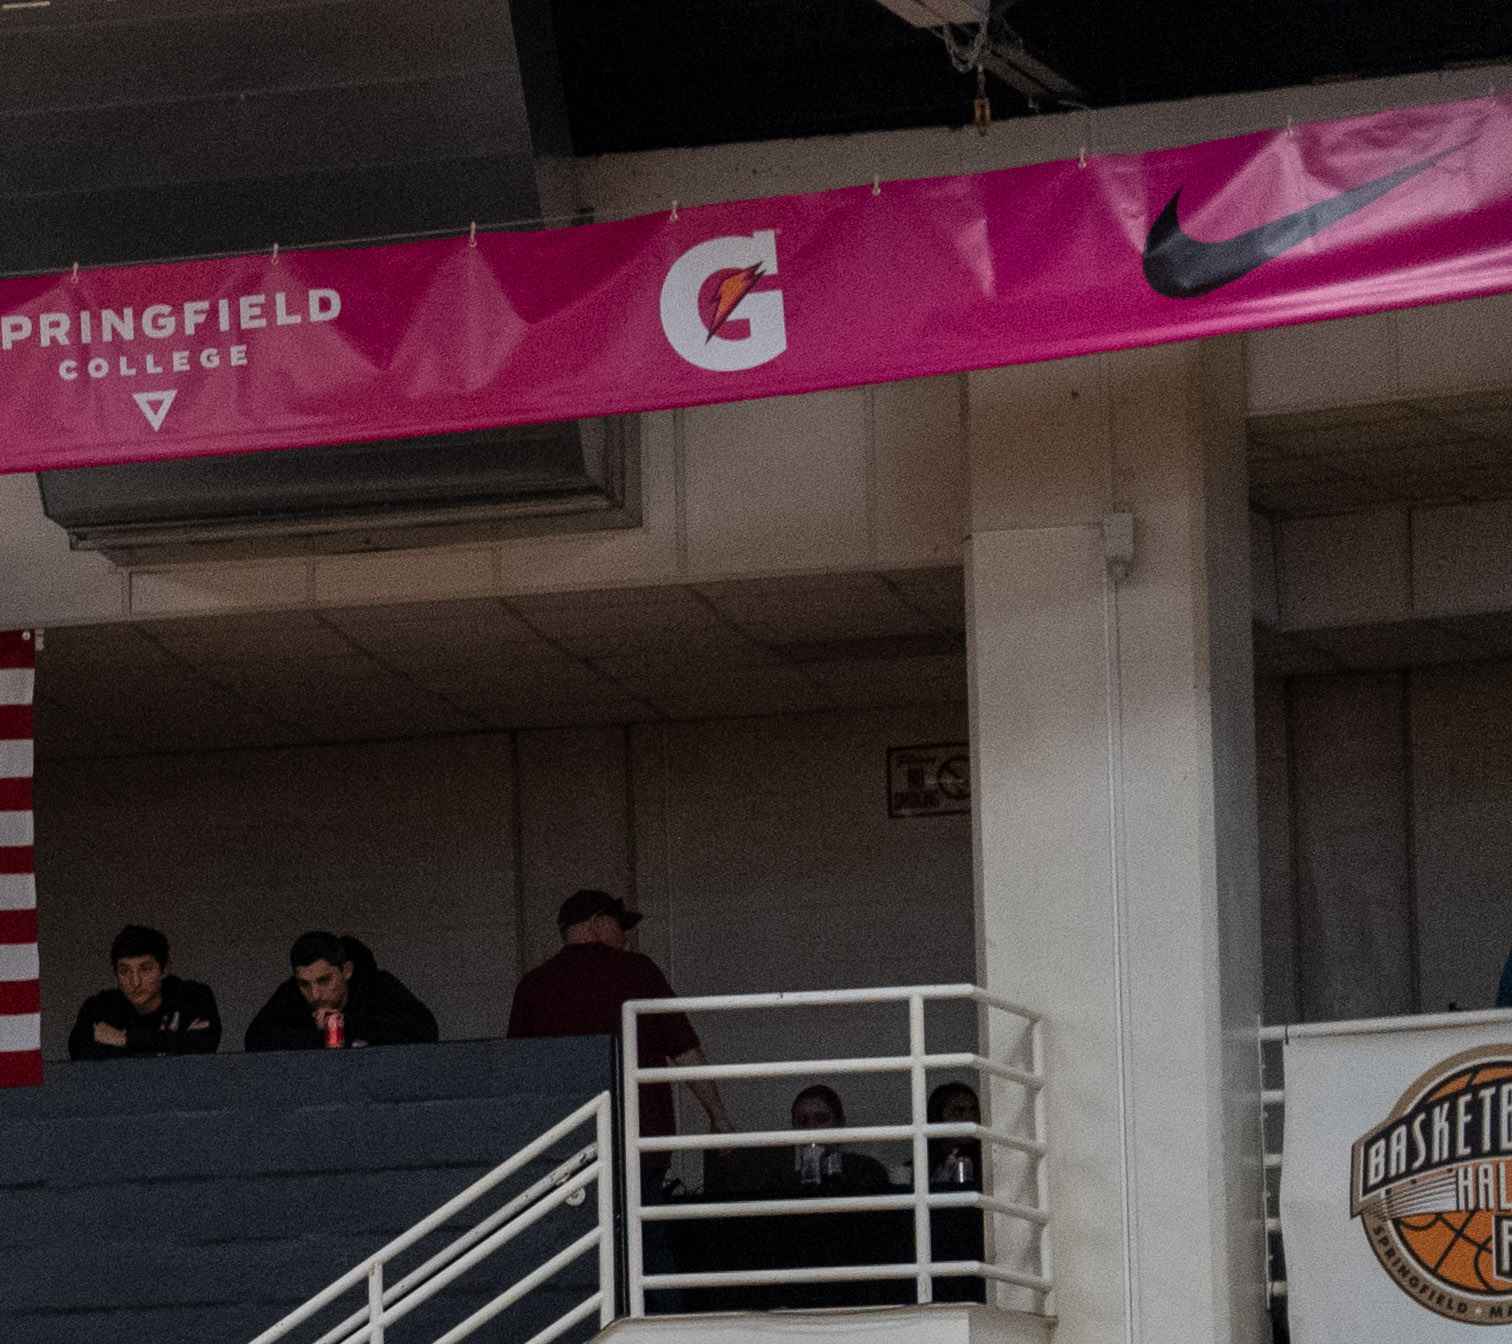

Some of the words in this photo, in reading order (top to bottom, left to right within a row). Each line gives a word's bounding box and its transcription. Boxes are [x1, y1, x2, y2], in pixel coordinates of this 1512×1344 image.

[58, 342, 251, 382] COLLEGE
[1368, 1087, 1512, 1187] BASKETB
[1455, 1163, 1512, 1212] HAL
